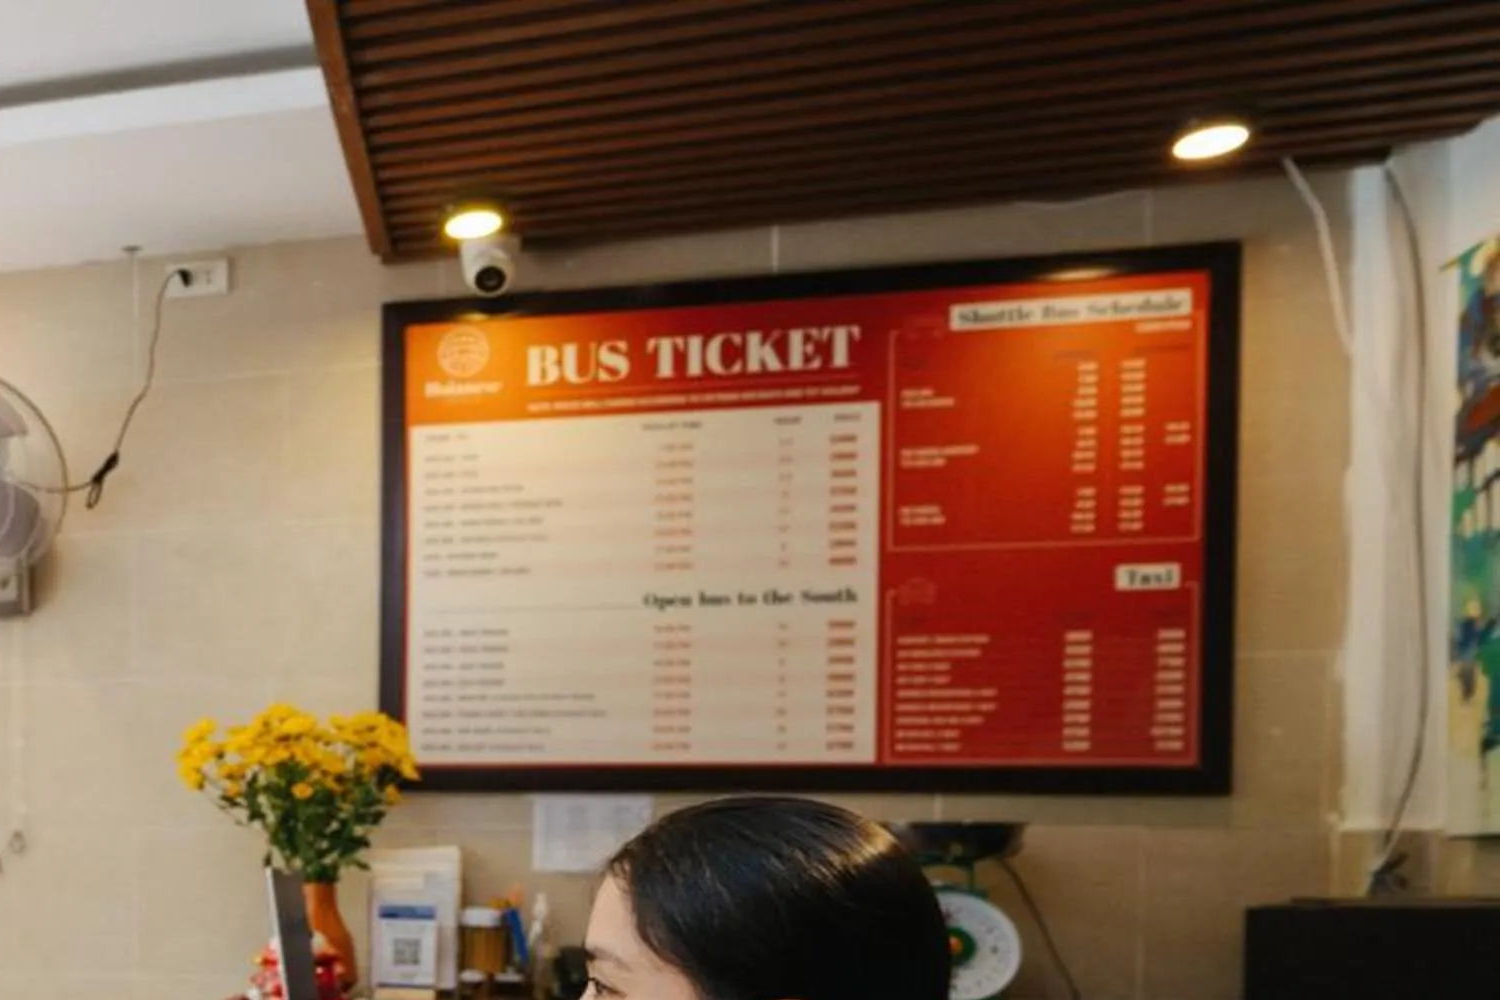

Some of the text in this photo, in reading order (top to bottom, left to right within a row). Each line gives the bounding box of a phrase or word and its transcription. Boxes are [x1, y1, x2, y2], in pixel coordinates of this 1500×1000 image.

[526, 325, 862, 386] BUS TICKET
[642, 587, 859, 612] Open bus to the South
